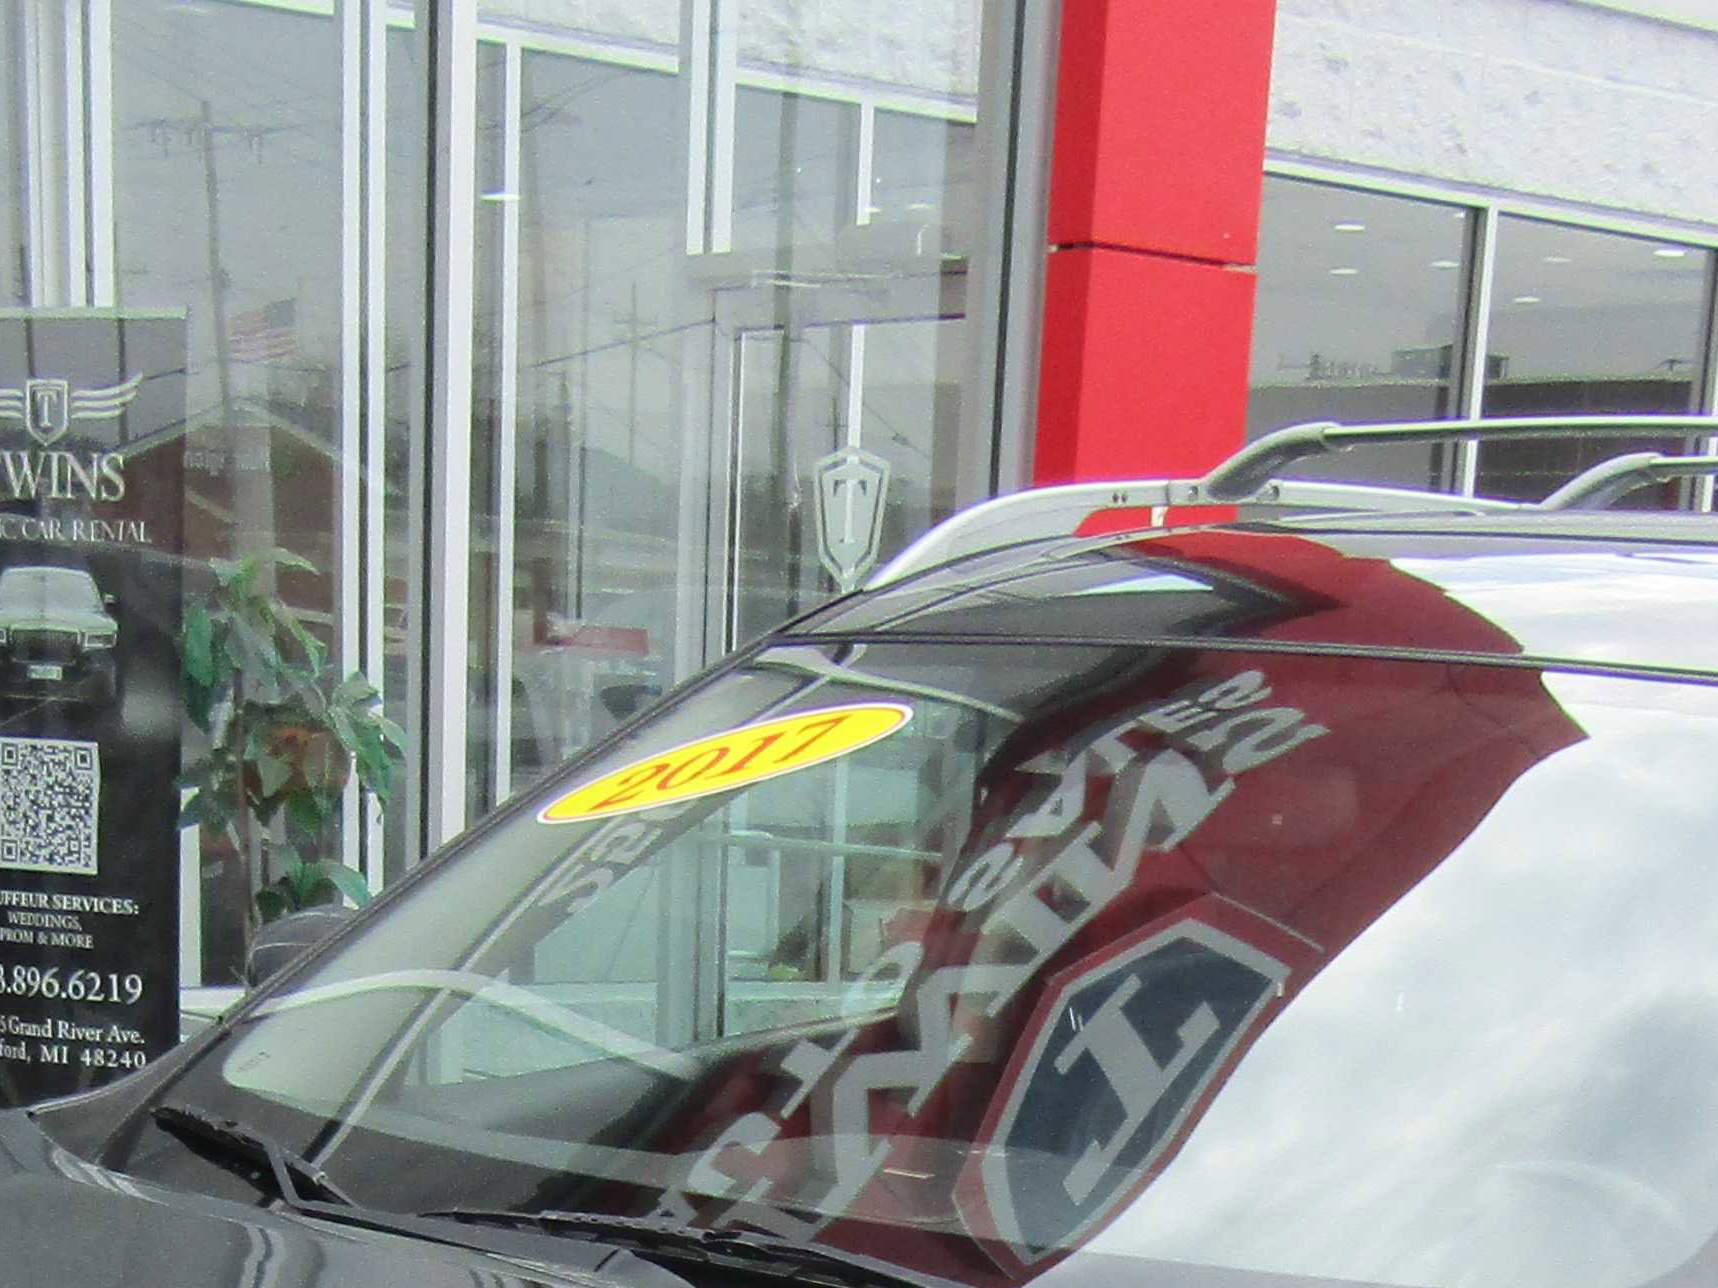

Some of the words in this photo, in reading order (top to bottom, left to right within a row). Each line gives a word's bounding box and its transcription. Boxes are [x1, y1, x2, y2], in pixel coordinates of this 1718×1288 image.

[22, 519, 65, 541] CAR
[72, 520, 152, 543] RENTAL
[587, 713, 856, 812] 2017
[52, 894, 140, 915] SERVICES:
[0, 927, 33, 943] PROM
[51, 933, 94, 949] MORE
[7, 1015, 53, 1039] Grand
[56, 1019, 105, 1042] River
[106, 1024, 145, 1044] Ave.
[40, 1044, 69, 1065] MI
[80, 1047, 147, 1068] 48240
